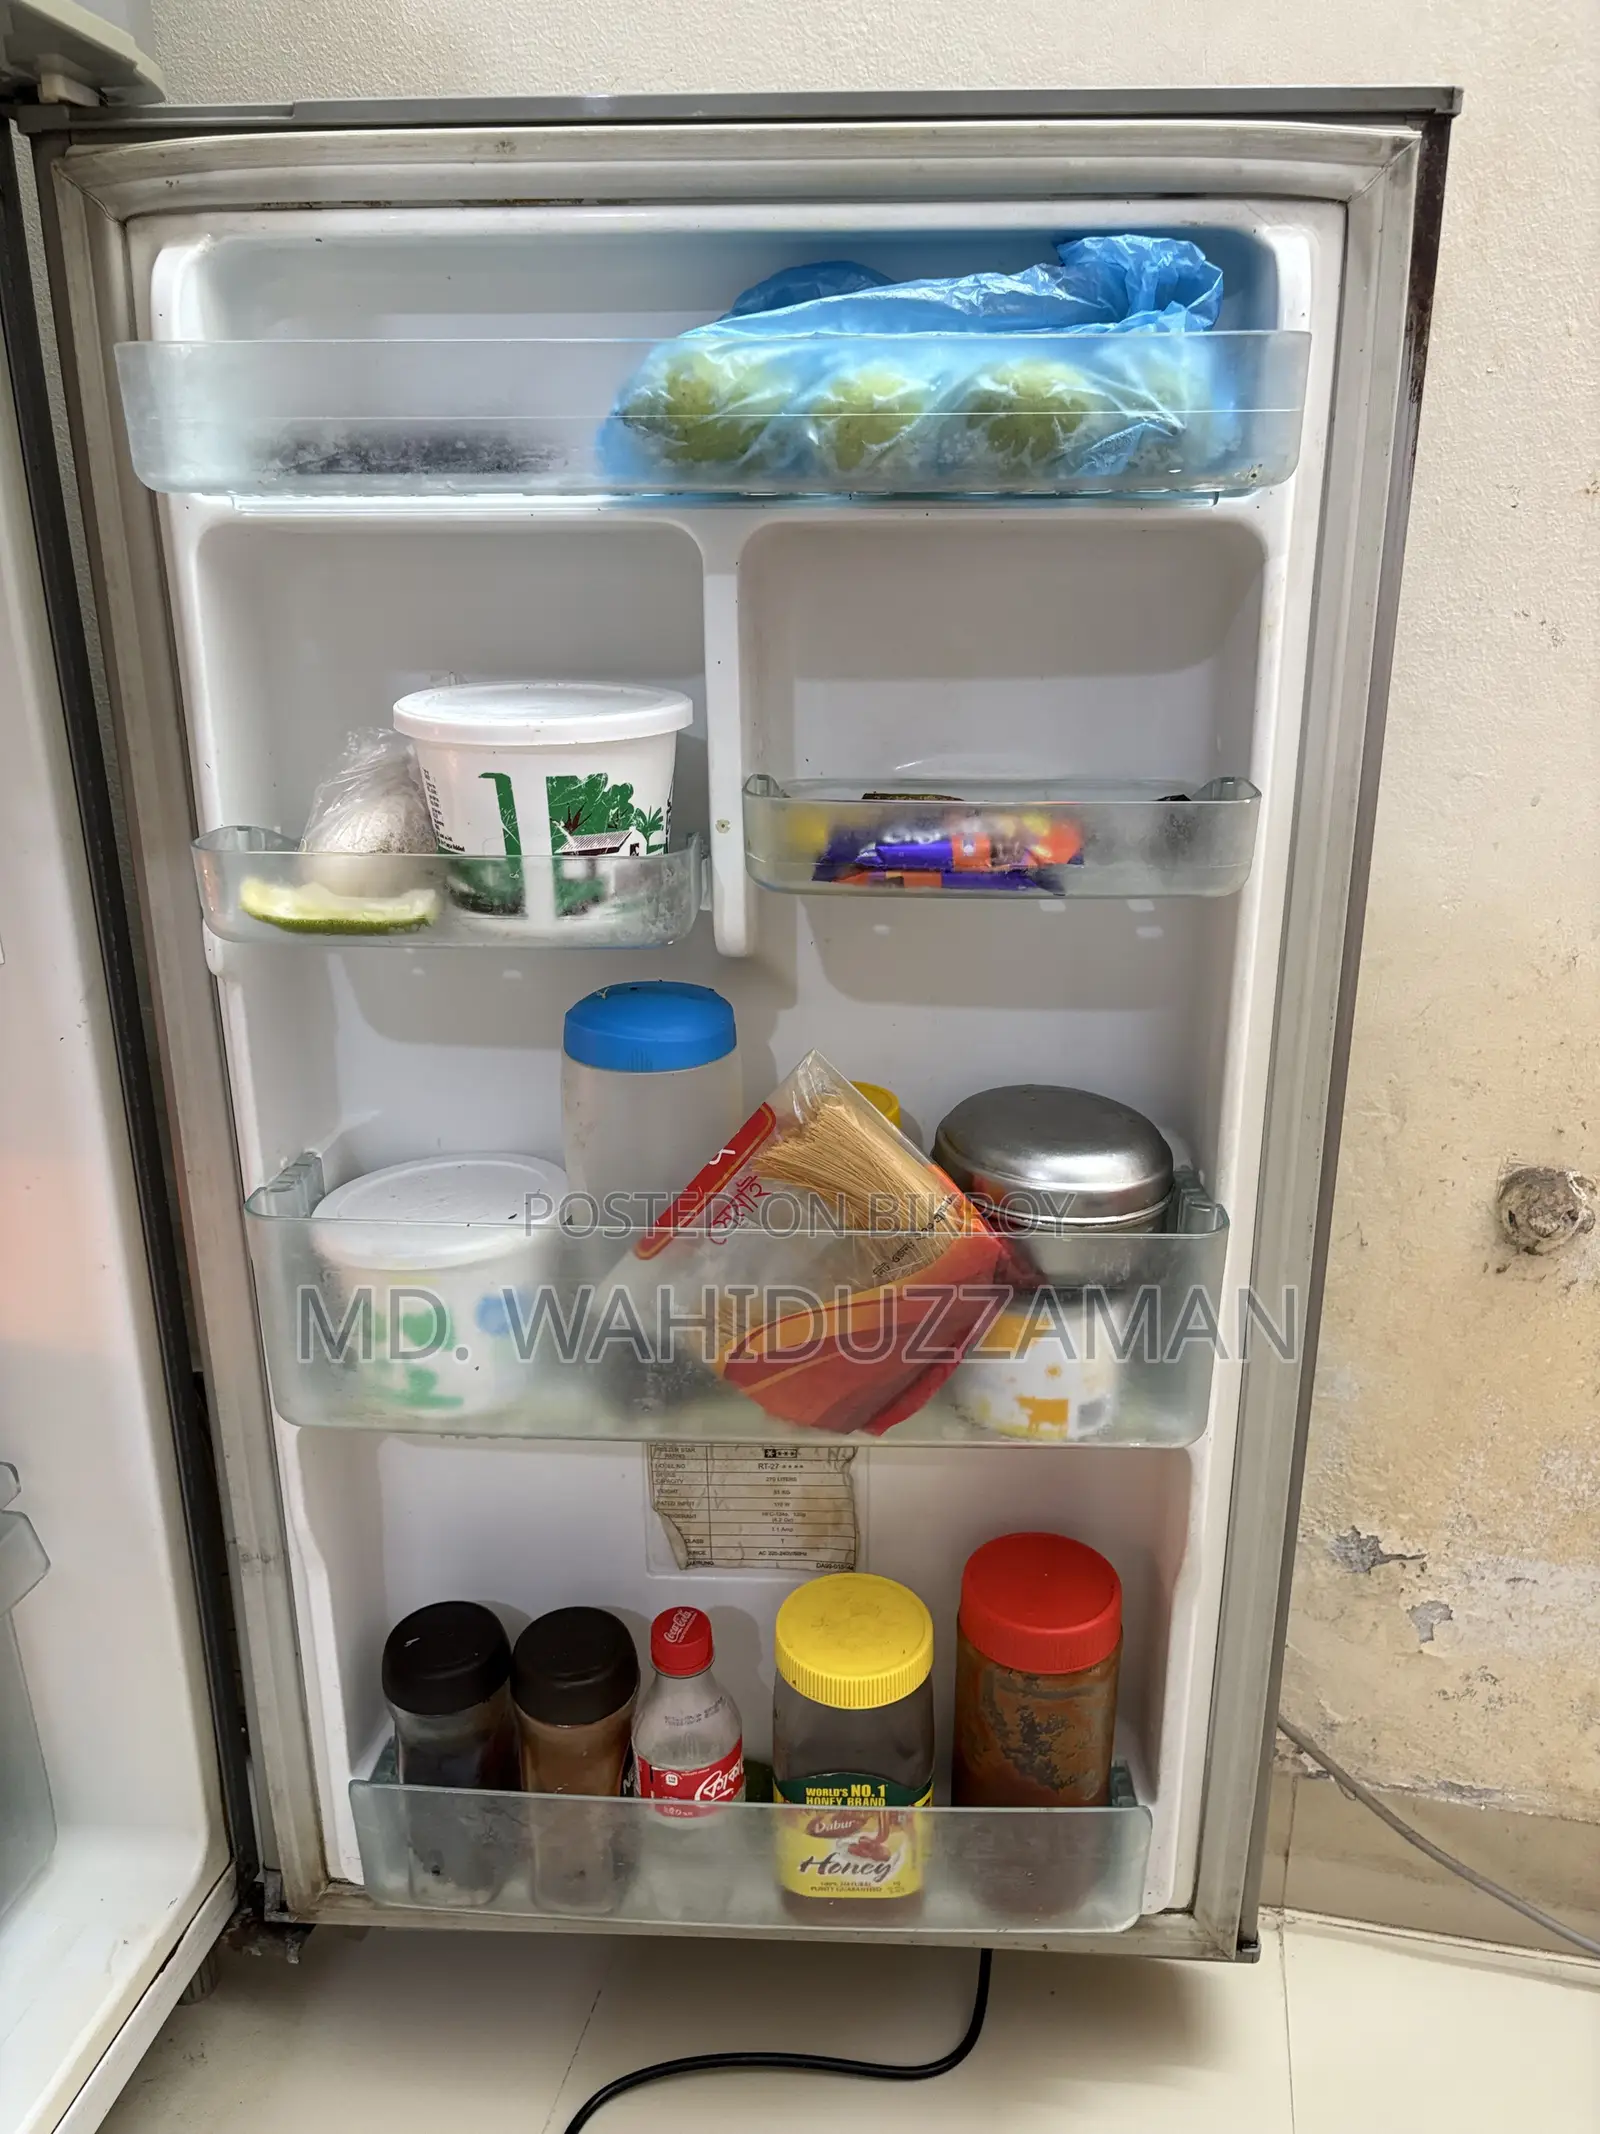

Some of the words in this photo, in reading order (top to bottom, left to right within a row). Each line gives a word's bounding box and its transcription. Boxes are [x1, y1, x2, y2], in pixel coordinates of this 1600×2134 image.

[758, 1462, 780, 1470] RT-27
[805, 1787, 849, 1797] WORLD'S
[850, 1784, 876, 1797] NO.
[877, 1784, 887, 1797] 1
[805, 1797, 842, 1806] HONEY
[846, 1797, 887, 1807] BRAND
[814, 1820, 856, 1834] Dabur
[799, 1852, 897, 1883] Honey
